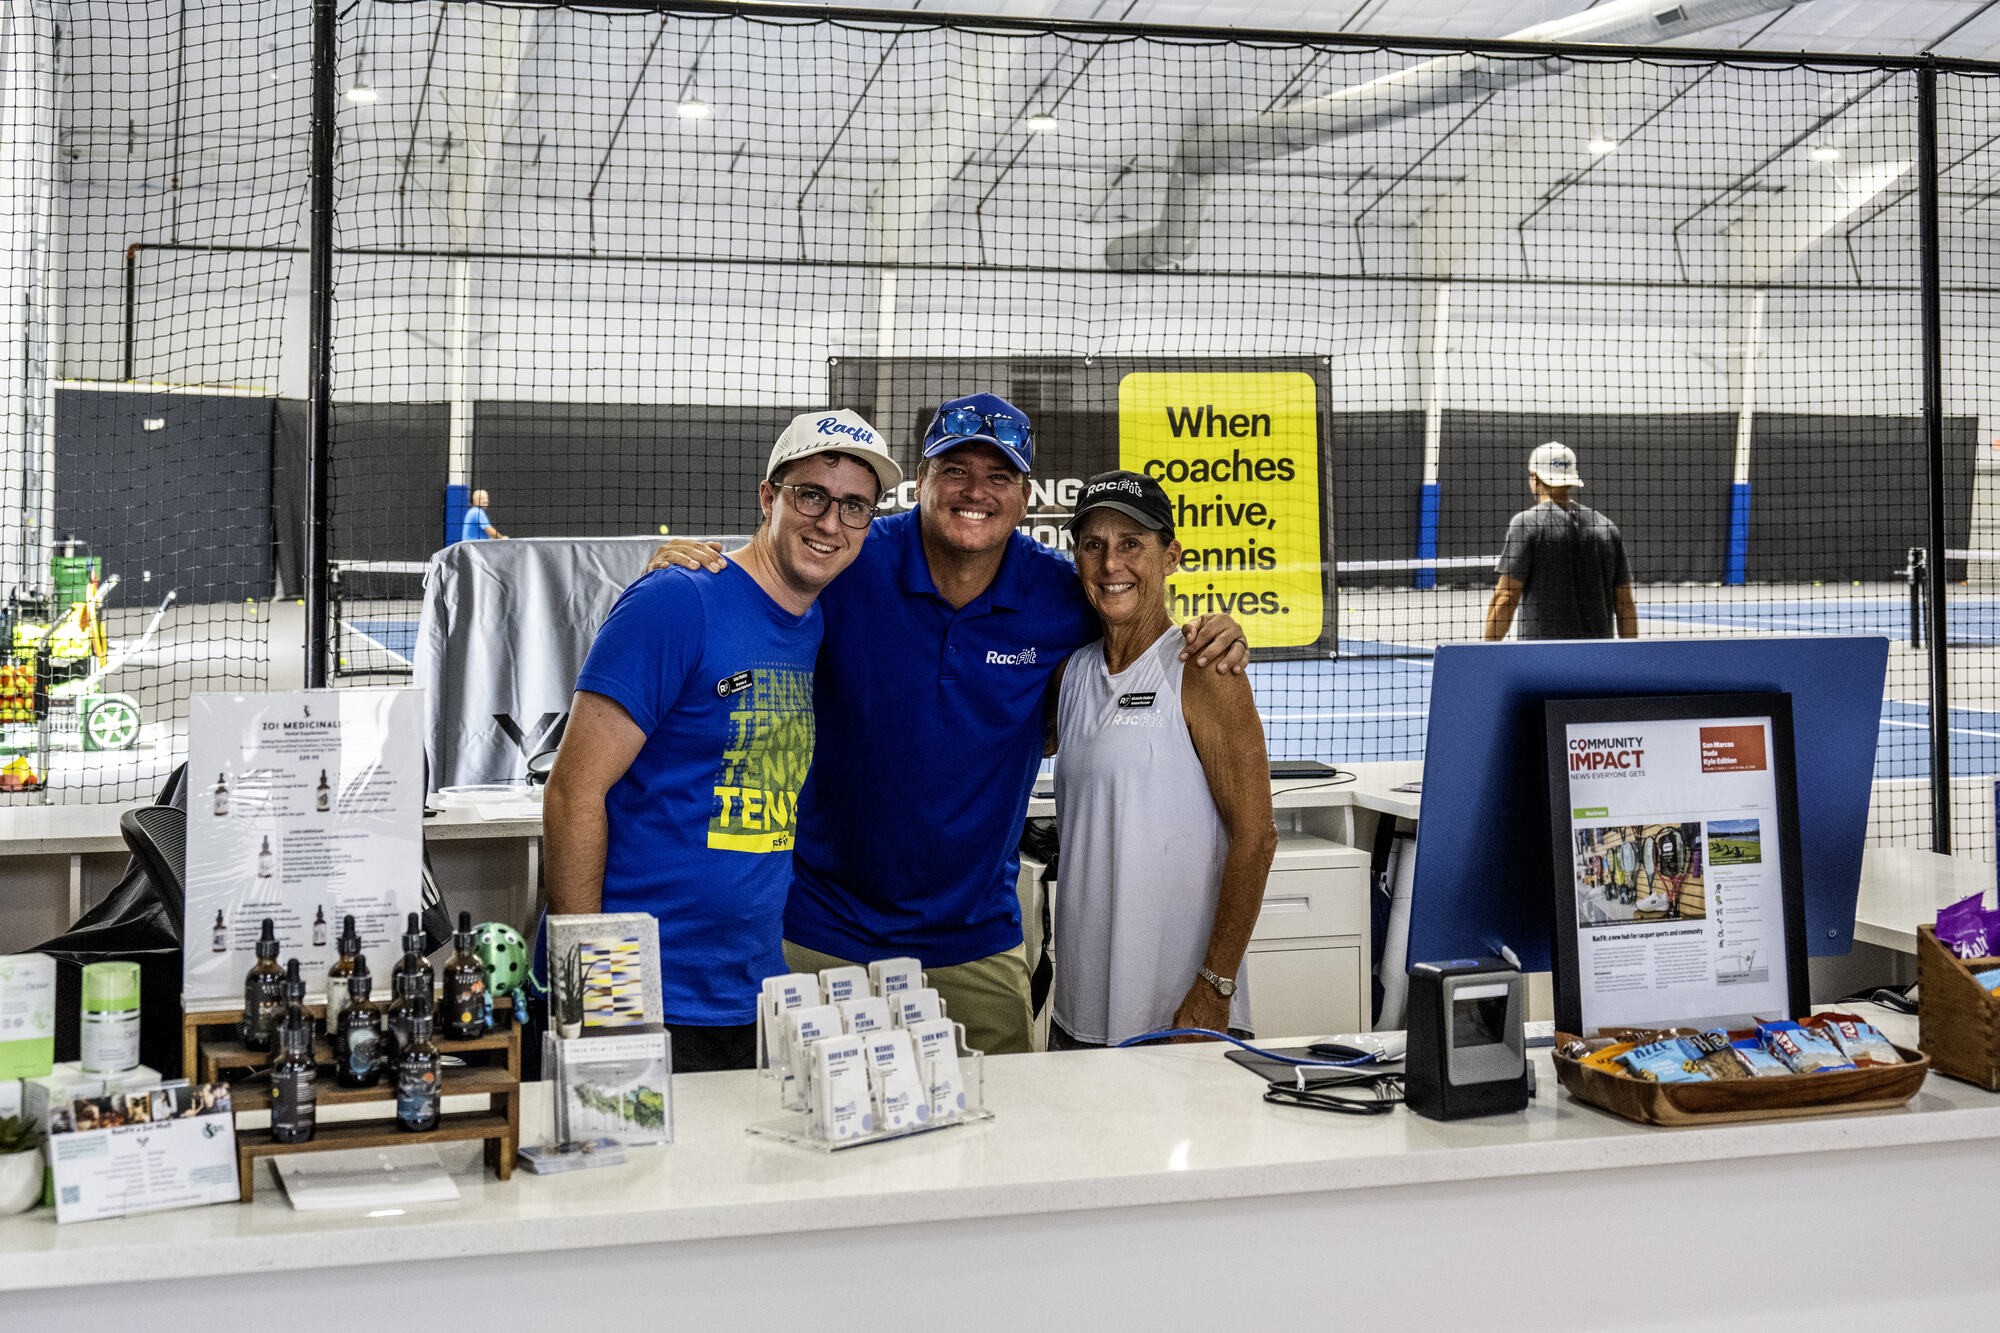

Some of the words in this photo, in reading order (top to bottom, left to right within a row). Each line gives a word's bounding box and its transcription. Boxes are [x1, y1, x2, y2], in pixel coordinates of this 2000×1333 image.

[816, 417, 873, 445] Racfit
[1166, 405, 1271, 438] When
[1143, 449, 1295, 483] coaches
[1171, 494, 1277, 531] hrive,
[1176, 538, 1277, 572] ennis
[1168, 583, 1290, 616] hrives.
[986, 647, 1037, 665] RacFit
[1569, 736, 1643, 752] COMMUNITY
[1569, 750, 1645, 771] IMPACT
[1716, 757, 1738, 765] Edition
[1592, 771, 1627, 780] EVERYONE
[1628, 770, 1646, 778] GETS
